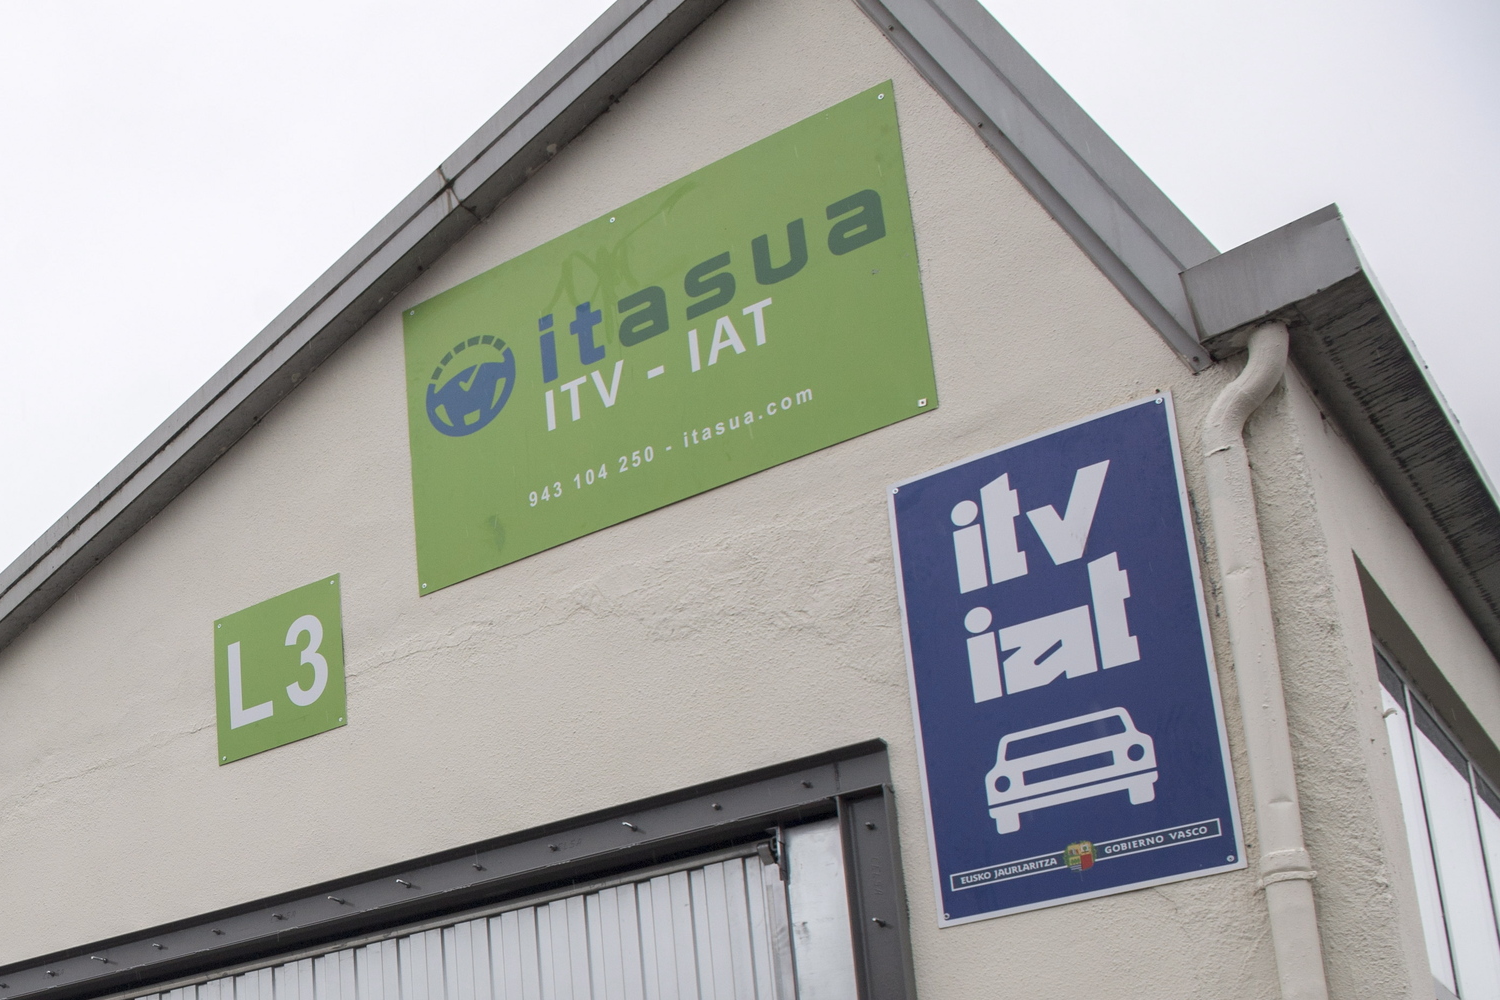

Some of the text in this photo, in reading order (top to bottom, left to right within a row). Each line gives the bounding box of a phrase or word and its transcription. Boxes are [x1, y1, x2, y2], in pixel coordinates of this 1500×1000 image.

[537, 188, 887, 384] itasua
[545, 297, 773, 432] ITV - IAT
[528, 481, 563, 507] 943
[573, 463, 608, 490] 104
[618, 445, 654, 474] 250
[682, 387, 814, 449] itasua.com
[950, 459, 1110, 594] itv
[960, 857, 1058, 885] EUSKO JAURLARITZA
[1104, 825, 1208, 855] GOBIERNO VASCO
